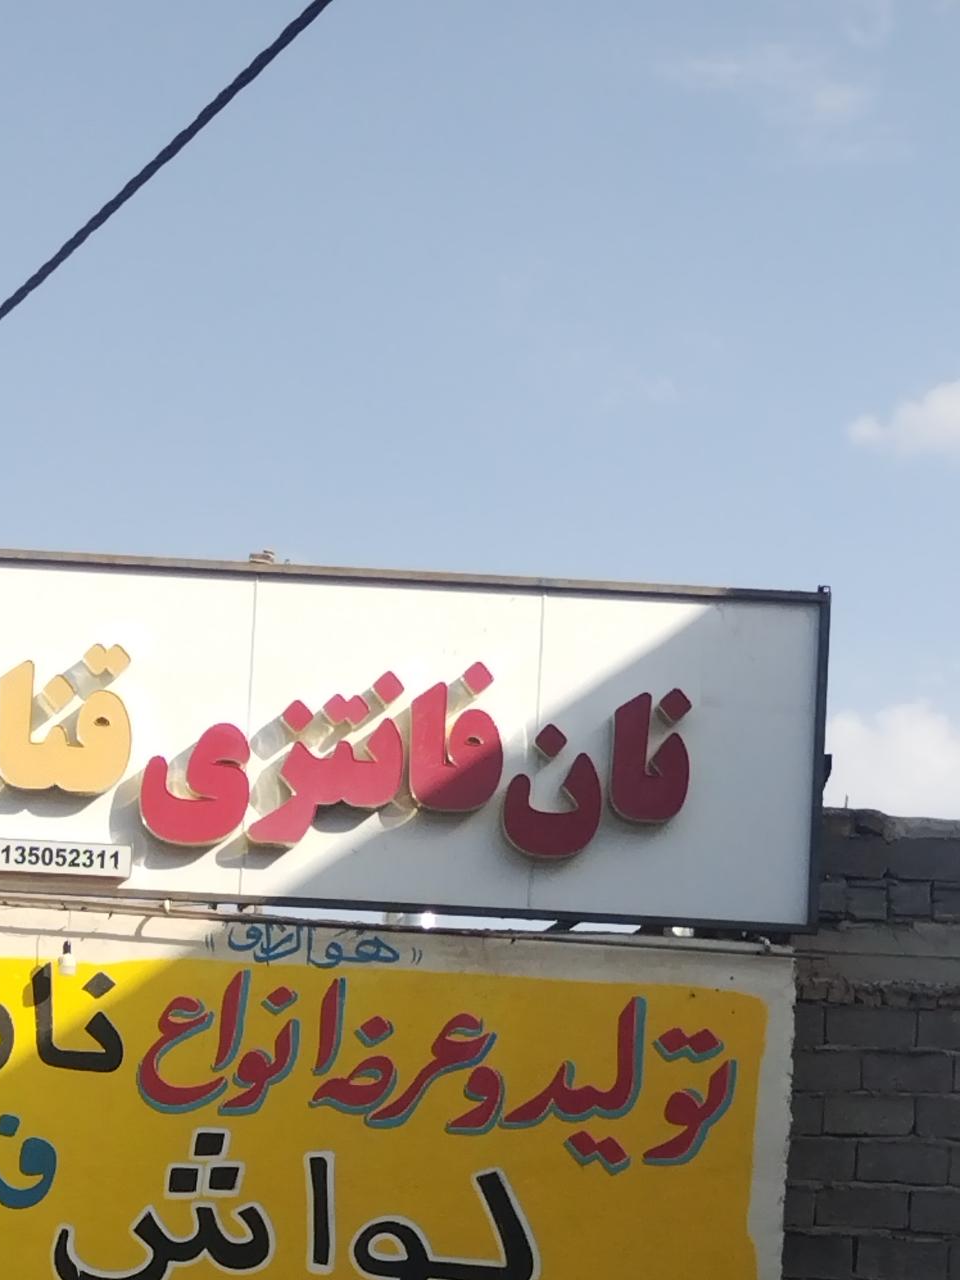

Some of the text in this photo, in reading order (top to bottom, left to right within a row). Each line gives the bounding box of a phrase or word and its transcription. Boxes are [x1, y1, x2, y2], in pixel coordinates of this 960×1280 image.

[140, 661, 504, 849] فانتزی
[502, 687, 692, 859] نان
[136, 967, 346, 1116] انواع
[309, 1013, 496, 1128] عرضه
[444, 1064, 505, 1135] و
[499, 996, 737, 1174] تولید
